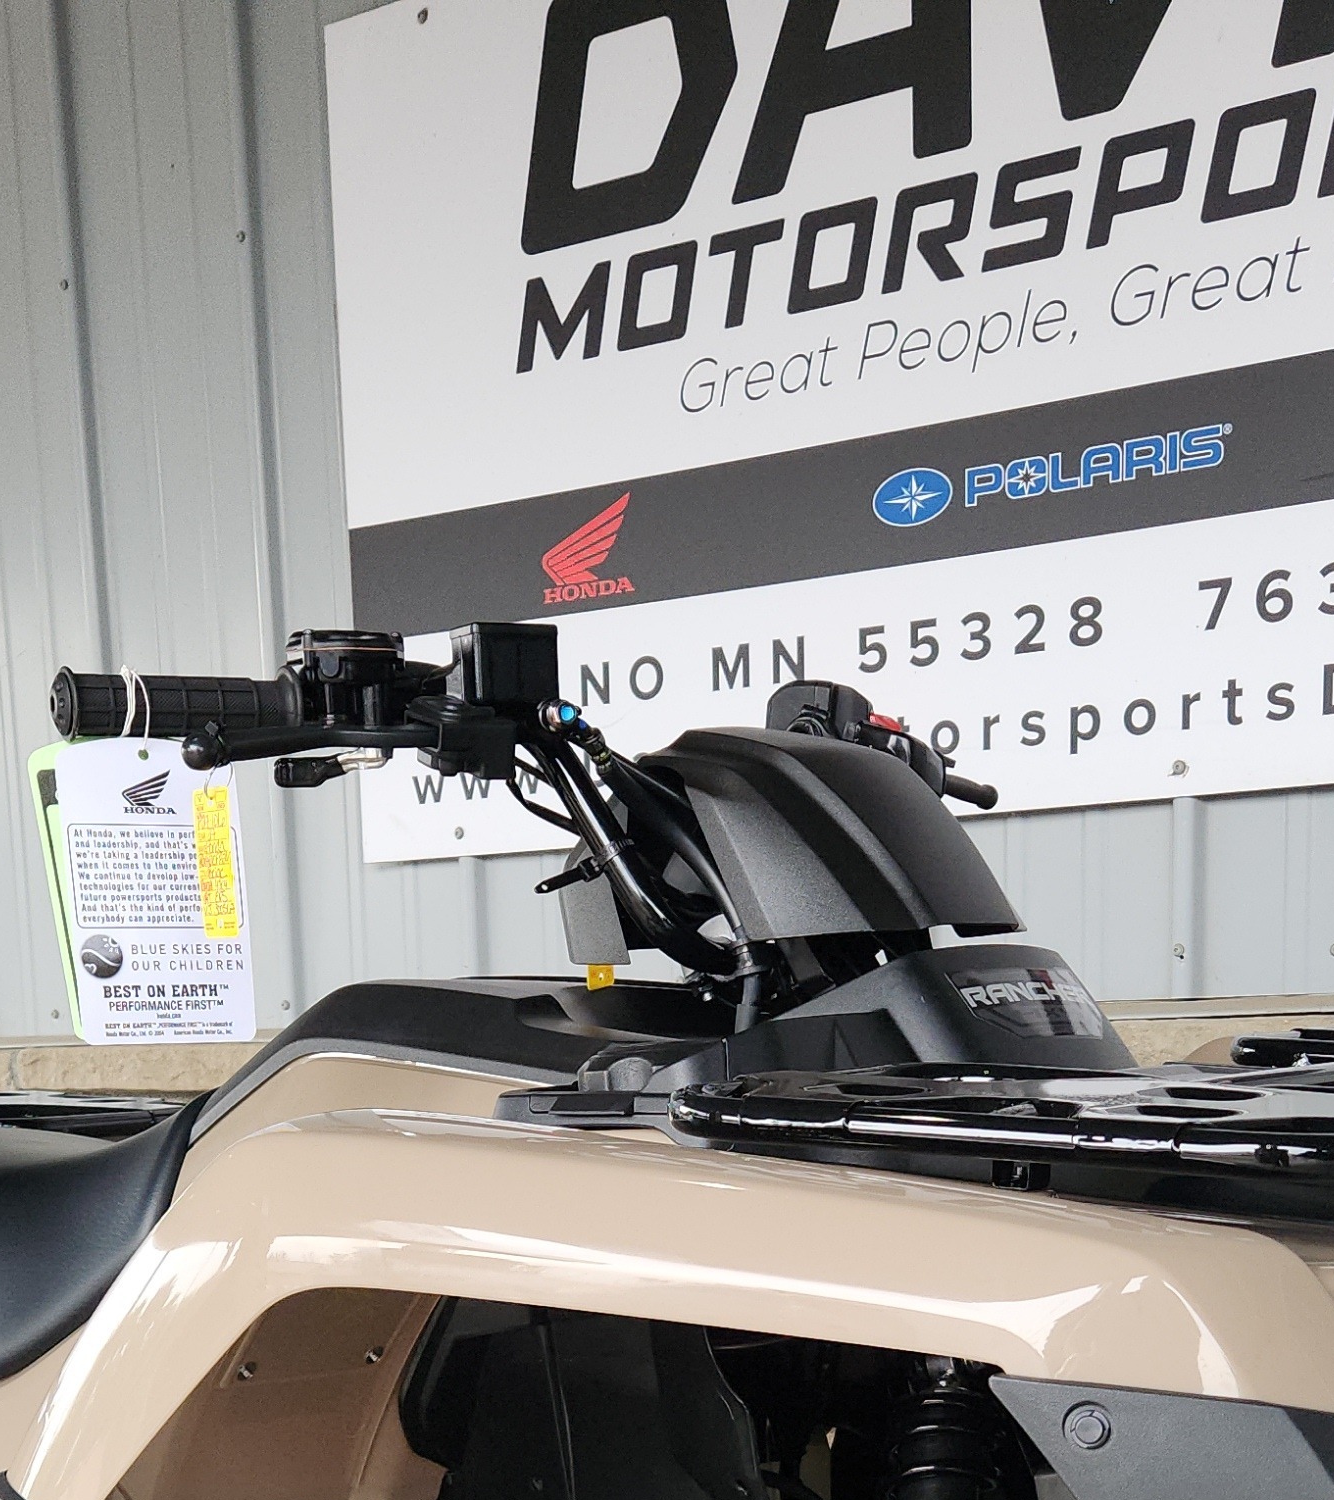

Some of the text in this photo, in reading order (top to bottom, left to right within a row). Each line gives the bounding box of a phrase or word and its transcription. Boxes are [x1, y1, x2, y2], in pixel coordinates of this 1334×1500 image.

[680, 336, 837, 413] Great
[858, 289, 1078, 381] People,
[1110, 236, 1311, 327] Great
[543, 576, 635, 604] HONDA
[711, 636, 805, 692] MN
[858, 598, 1103, 674] 55328
[74, 829, 83, 838] At
[135, 829, 164, 838] believe
[75, 840, 90, 848] and
[93, 841, 142, 850] leadership,
[163, 841, 188, 849] that's
[76, 851, 100, 859] we're
[103, 851, 130, 860] taking
[142, 851, 185, 861] leadership
[77, 861, 99, 869] when
[102, 861, 109, 869] it
[154, 862, 168, 870] the
[78, 872, 90, 880] We
[94, 872, 131, 880] continue
[134, 872, 143, 880] to
[147, 872, 178, 882] develop
[80, 882, 134, 892] technologies
[137, 882, 150, 890] for
[169, 883, 200, 891] current
[80, 893, 107, 901] future
[111, 893, 162, 903] powersports
[166, 893, 201, 902] products
[82, 904, 97, 912] And
[101, 904, 126, 912] that's
[147, 904, 164, 912] kind
[168, 904, 176, 912] of
[82, 915, 125, 924] everybody
[147, 915, 194, 924] appreciate.
[131, 943, 242, 955] BLUE SKIES FOR
[131, 960, 244, 971] OUR CHILDREN
[103, 985, 141, 998] BEST
[147, 985, 166, 998] ON
[960, 981, 1091, 1009] RANCHER
[109, 1000, 183, 1012] PERFORMANCE
